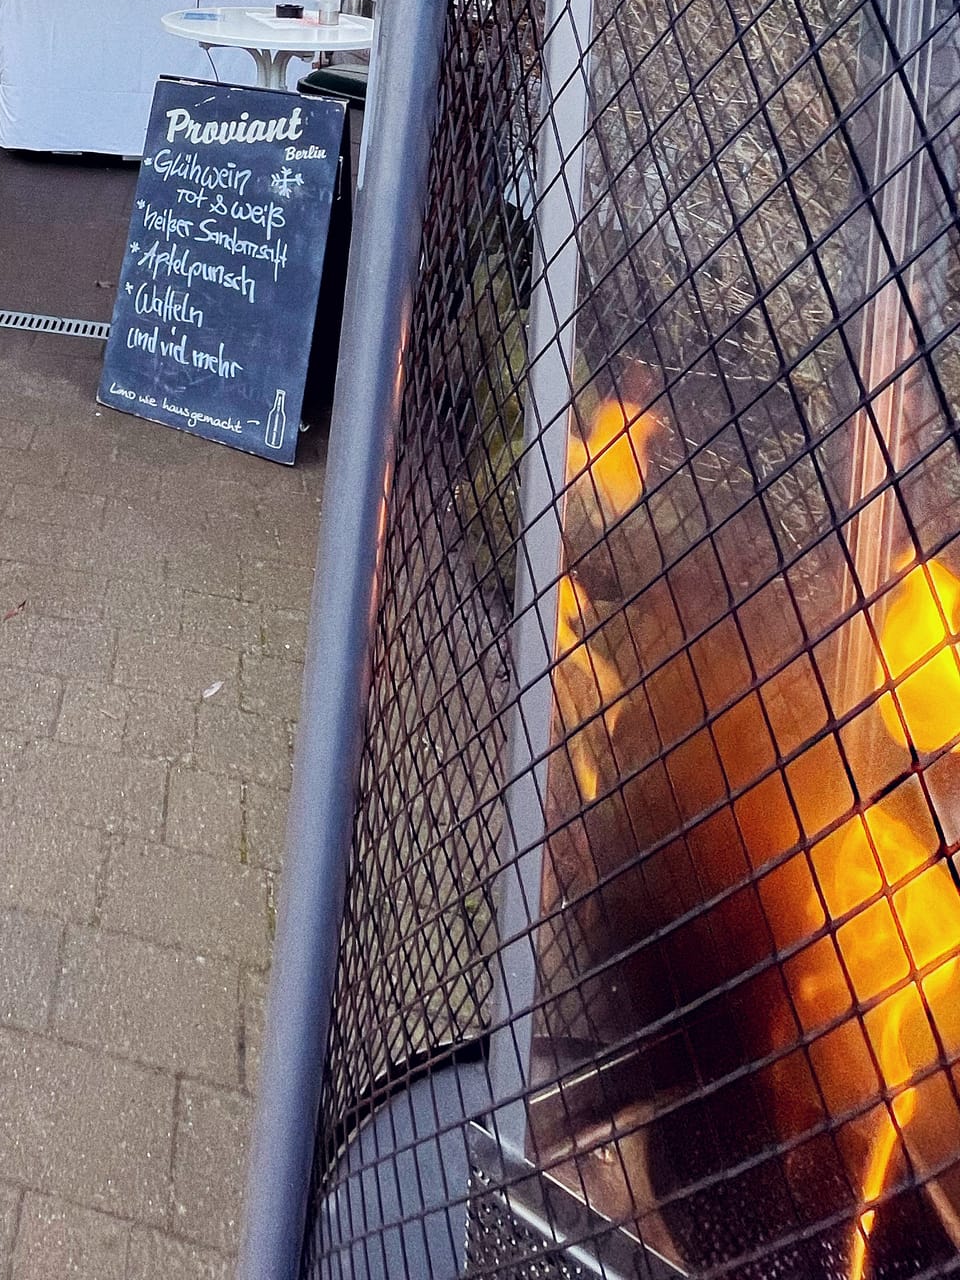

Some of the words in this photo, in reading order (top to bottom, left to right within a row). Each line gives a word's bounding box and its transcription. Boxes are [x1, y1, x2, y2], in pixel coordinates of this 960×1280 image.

[165, 107, 304, 145] Proviant
[153, 149, 252, 196] Glühwein
[284, 145, 327, 161] Berlin
[143, 204, 194, 241] heißer
[208, 194, 228, 215] &
[230, 201, 286, 240] weiß
[137, 240, 256, 303] Apfelpunsch
[134, 282, 204, 328] Waffeln
[160, 326, 190, 365] viel
[192, 342, 244, 379] mehr
[162, 397, 243, 434] hausgemacht
